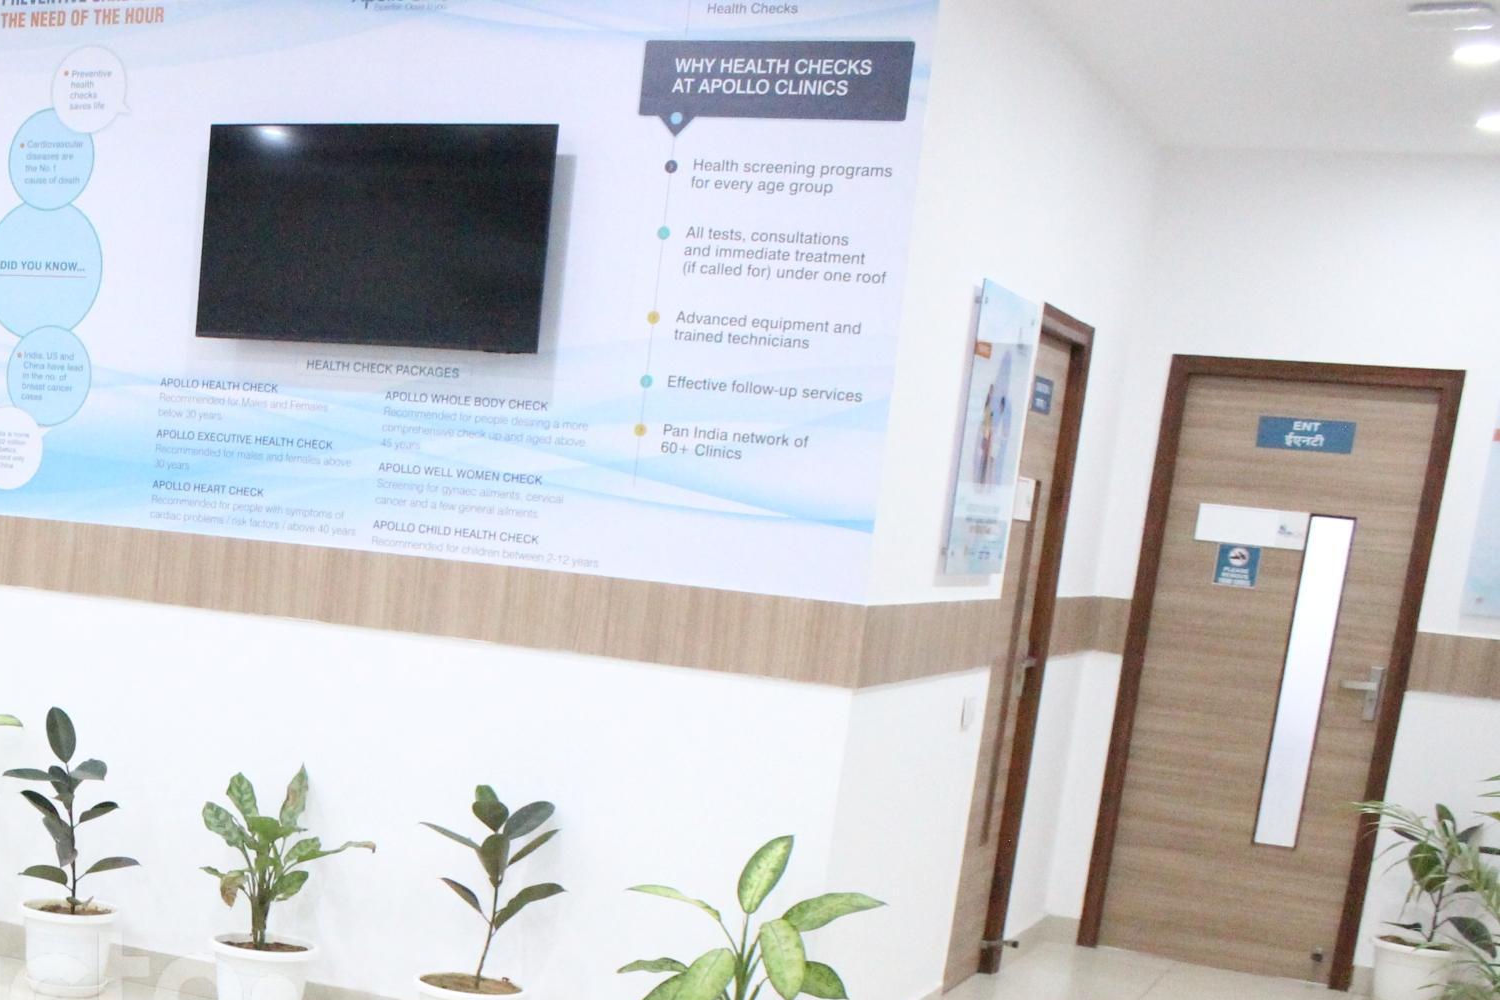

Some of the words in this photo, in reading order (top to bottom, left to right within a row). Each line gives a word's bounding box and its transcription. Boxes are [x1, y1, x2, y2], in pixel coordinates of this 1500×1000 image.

[1, 12, 26, 28] THE
[31, 11, 65, 27] NEED
[71, 10, 88, 26] OF
[94, 9, 120, 25] THE
[125, 7, 164, 24] HOUR
[707, 2, 747, 14] Health
[751, 2, 798, 14] Checks
[675, 58, 717, 73] WHY
[720, 59, 789, 74] HEALTH
[795, 60, 872, 75] CHECKS
[672, 79, 695, 93] AT
[698, 79, 770, 95] APOLLO
[775, 80, 848, 96] CLINICS
[693, 159, 738, 172] Health
[744, 161, 815, 178] screening
[820, 162, 893, 180] programs
[691, 176, 709, 188] for
[714, 179, 753, 193] every
[757, 180, 785, 194] age
[789, 180, 833, 196] group
[686, 226, 704, 239] All
[708, 228, 745, 242] tests,
[751, 230, 849, 246] consultations
[684, 245, 710, 256] and
[715, 246, 790, 261] immediate
[795, 250, 865, 265] treatment
[0, 261, 17, 270] DID
[21, 261, 42, 271] YOU
[682, 262, 696, 276] (if
[700, 263, 742, 277] called
[747, 265, 771, 280] for)
[777, 268, 819, 280] under
[824, 270, 851, 282] one
[856, 272, 887, 284] roof
[676, 311, 747, 327] Advanced
[752, 317, 829, 333] equipment
[834, 322, 861, 335] and
[675, 329, 722, 343] trained
[728, 333, 810, 349] technicians
[306, 359, 350, 371] HEALTH
[353, 362, 392, 374] CHECK
[396, 360, 460, 379] PACKAGES
[161, 378, 199, 389] APOLLO
[202, 380, 240, 391] HEALTH
[243, 383, 278, 393] CHECK
[667, 375, 727, 392] Effective
[731, 380, 797, 400] follow-up
[802, 388, 863, 403] services
[385, 391, 428, 403] APOLLO
[431, 393, 471, 406] WHOLE
[474, 397, 505, 408] BODY
[508, 399, 548, 411] CHECK
[663, 424, 689, 437] Pan
[694, 426, 728, 441] India
[733, 431, 789, 446] network
[794, 435, 809, 448] of
[1293, 421, 1321, 431] ENT
[157, 429, 195, 441] APOLLO
[198, 432, 252, 444] EXECUTIVE
[254, 436, 293, 447] HEALTH
[297, 439, 333, 449] CHECK
[1284, 433, 1325, 447] ईएनटी
[661, 441, 689, 455] 60+
[695, 444, 742, 460] Clinics
[379, 463, 421, 474] APOLLO
[424, 466, 453, 477] WELL
[457, 469, 500, 481] WOMEN
[503, 473, 543, 485] CHECK
[153, 480, 190, 491] APOLLO
[194, 484, 226, 494] HEART
[229, 486, 264, 497] CHECK
[373, 520, 415, 532] APOLLO
[419, 524, 451, 536] CHILD
[455, 528, 496, 540] HEALTH
[499, 532, 539, 544] CHECK
